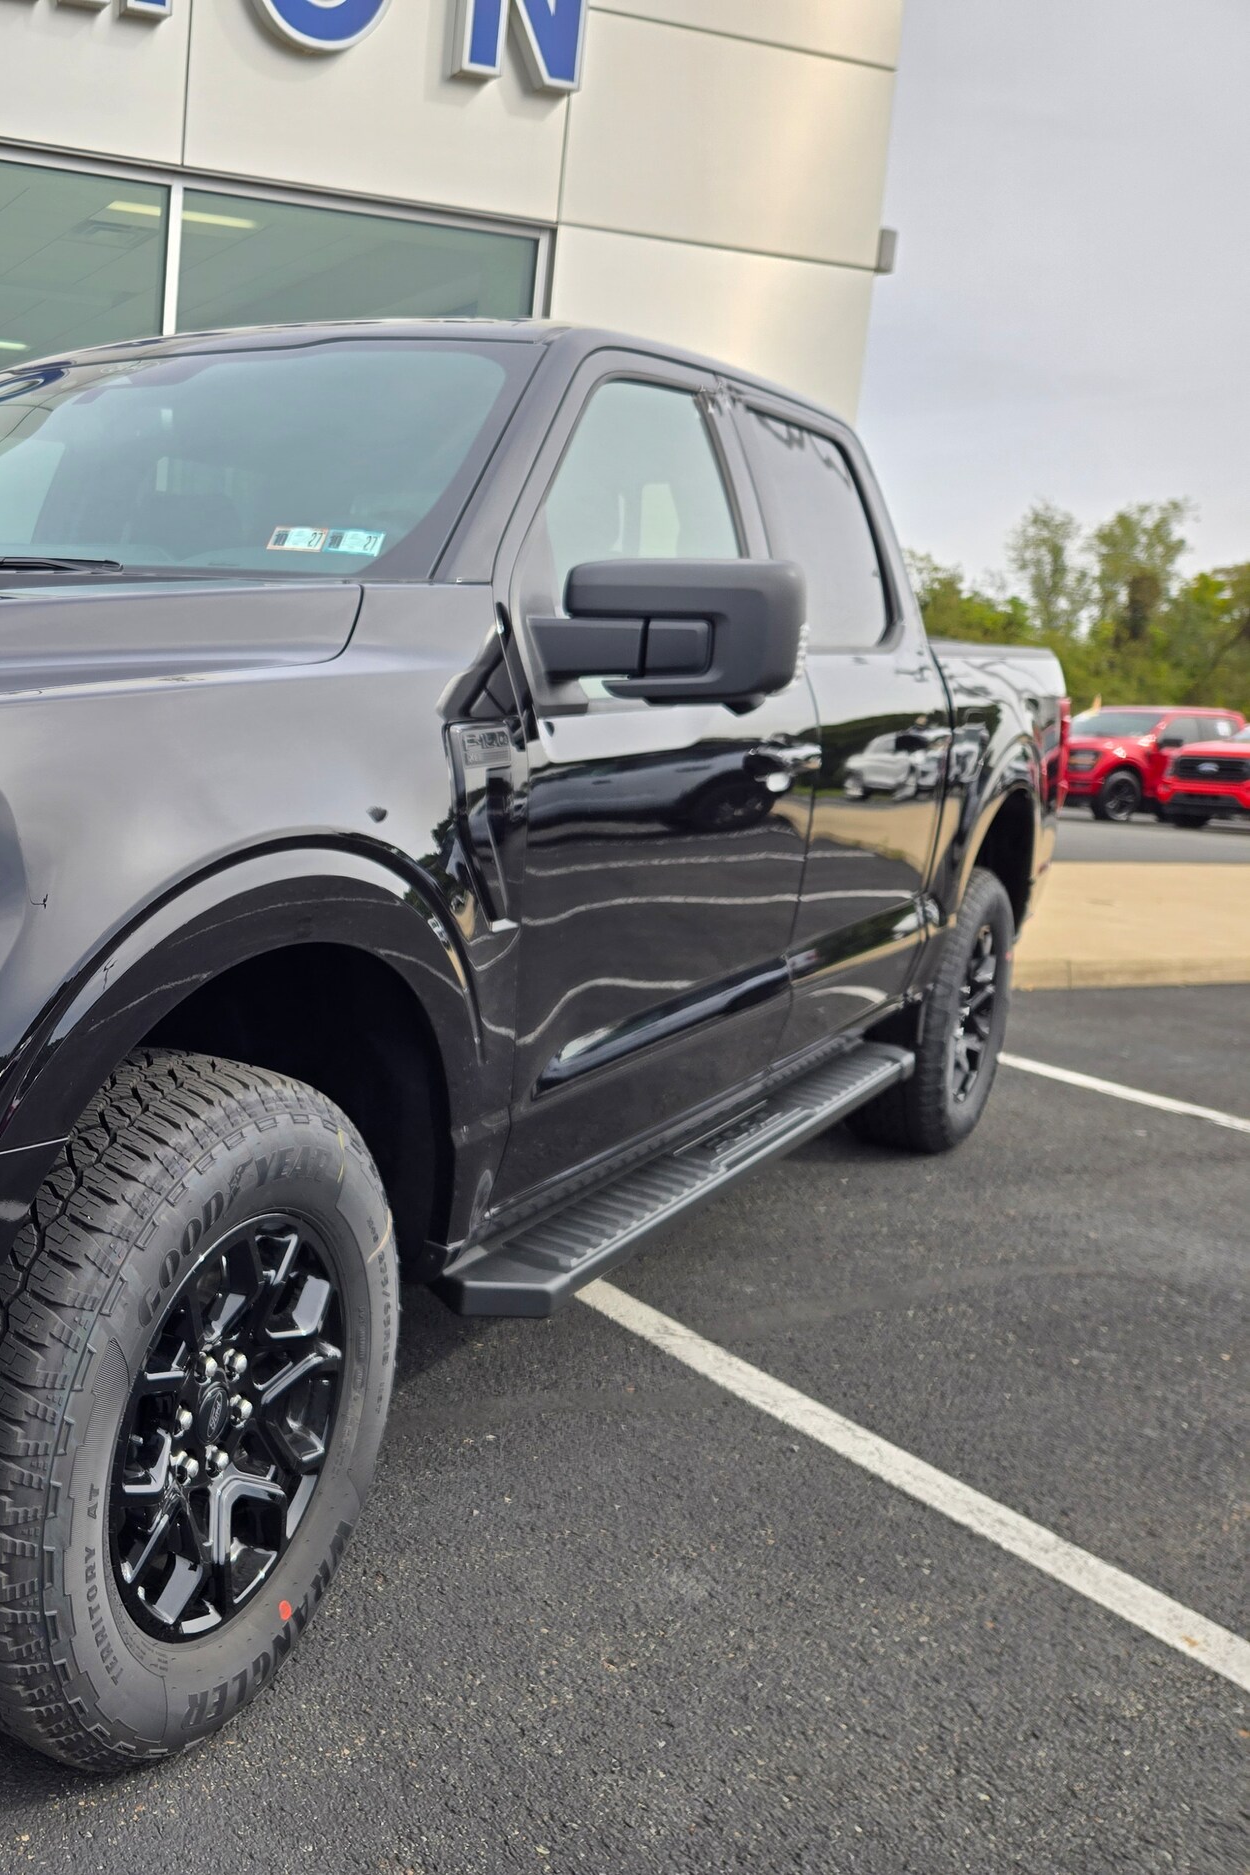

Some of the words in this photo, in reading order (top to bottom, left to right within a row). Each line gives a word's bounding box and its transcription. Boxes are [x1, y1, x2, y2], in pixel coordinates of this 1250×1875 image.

[307, 532, 324, 547] 27
[363, 536, 378, 551] 27
[138, 1145, 334, 1328] GOODYEAR
[87, 1482, 100, 1519] AT
[84, 1545, 123, 1686] TERRITORY
